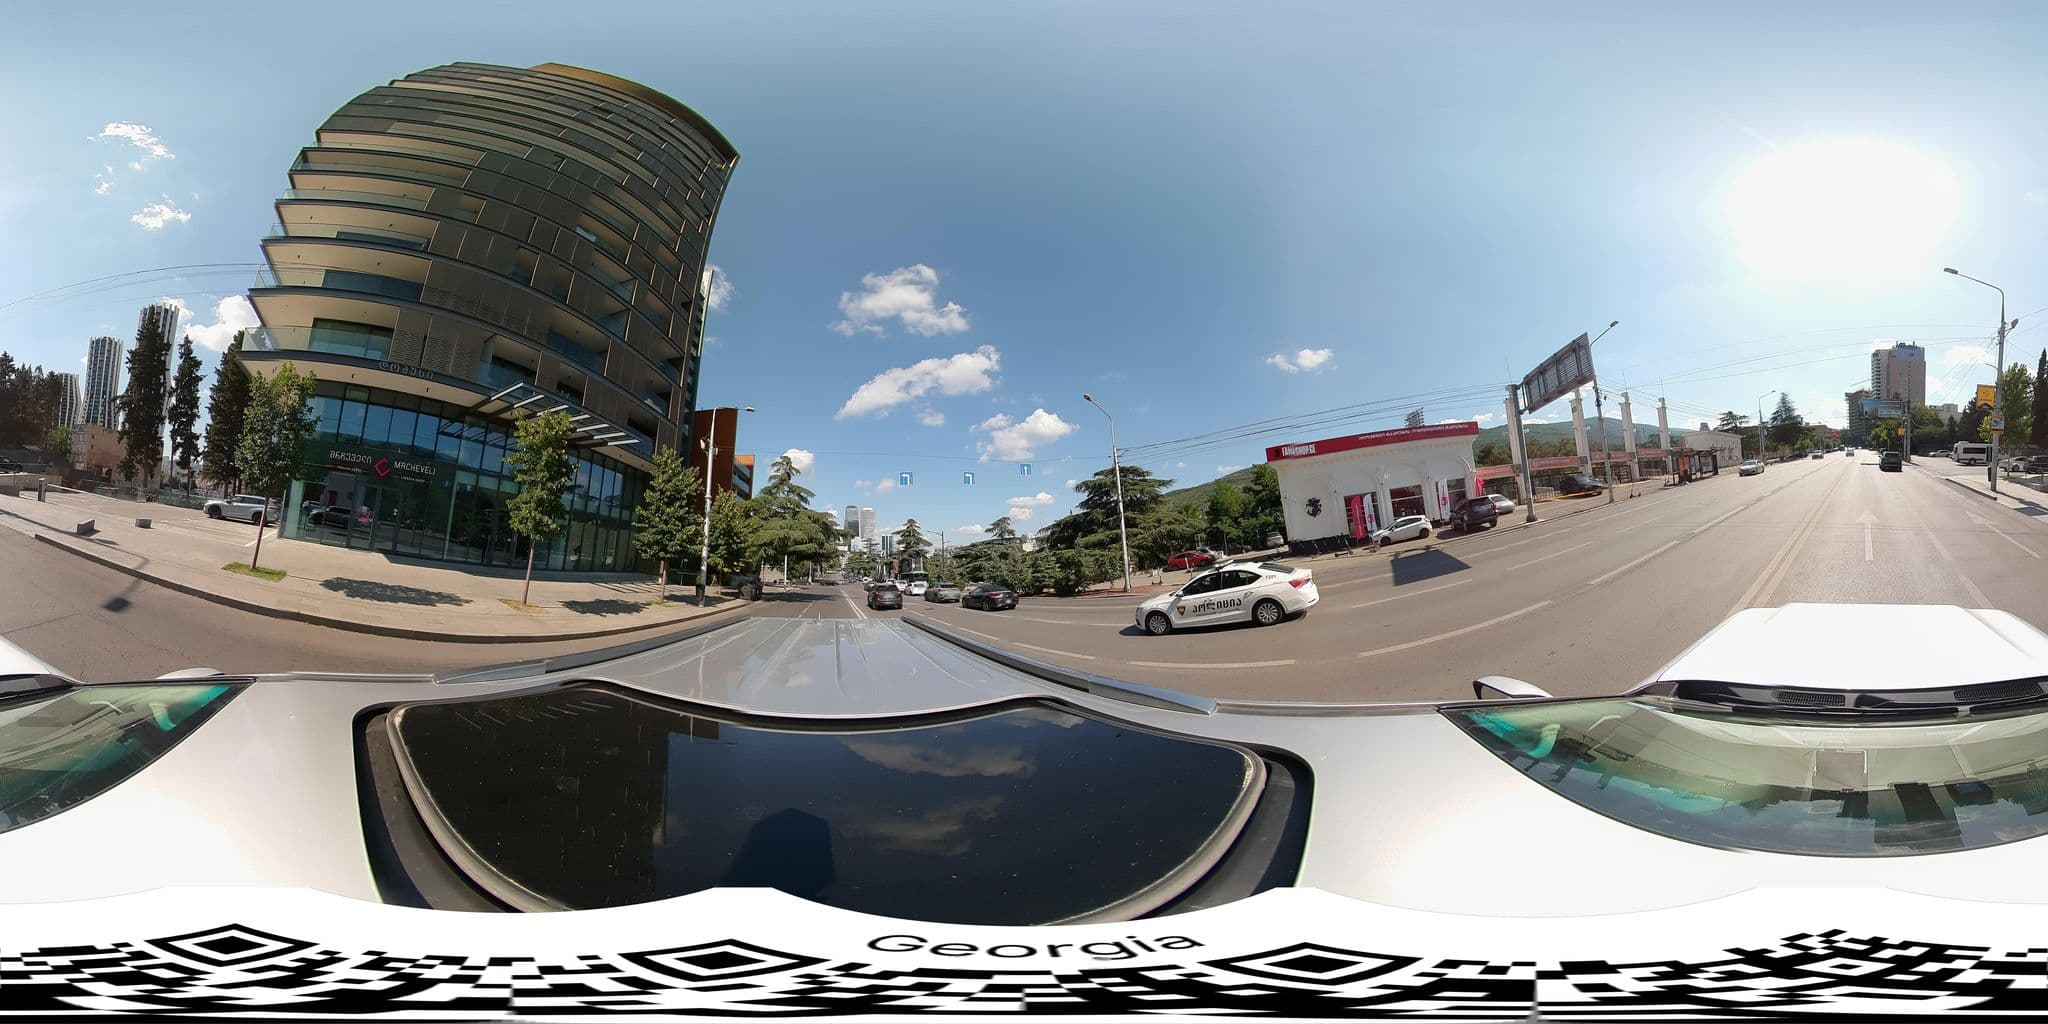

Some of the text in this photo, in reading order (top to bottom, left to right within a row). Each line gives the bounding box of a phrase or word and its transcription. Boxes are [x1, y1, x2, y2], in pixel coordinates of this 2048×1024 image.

[329, 450, 372, 464] მრჩეველი
[393, 461, 436, 475] MRCHEVELI
[1192, 598, 1242, 613] პოლიცია
